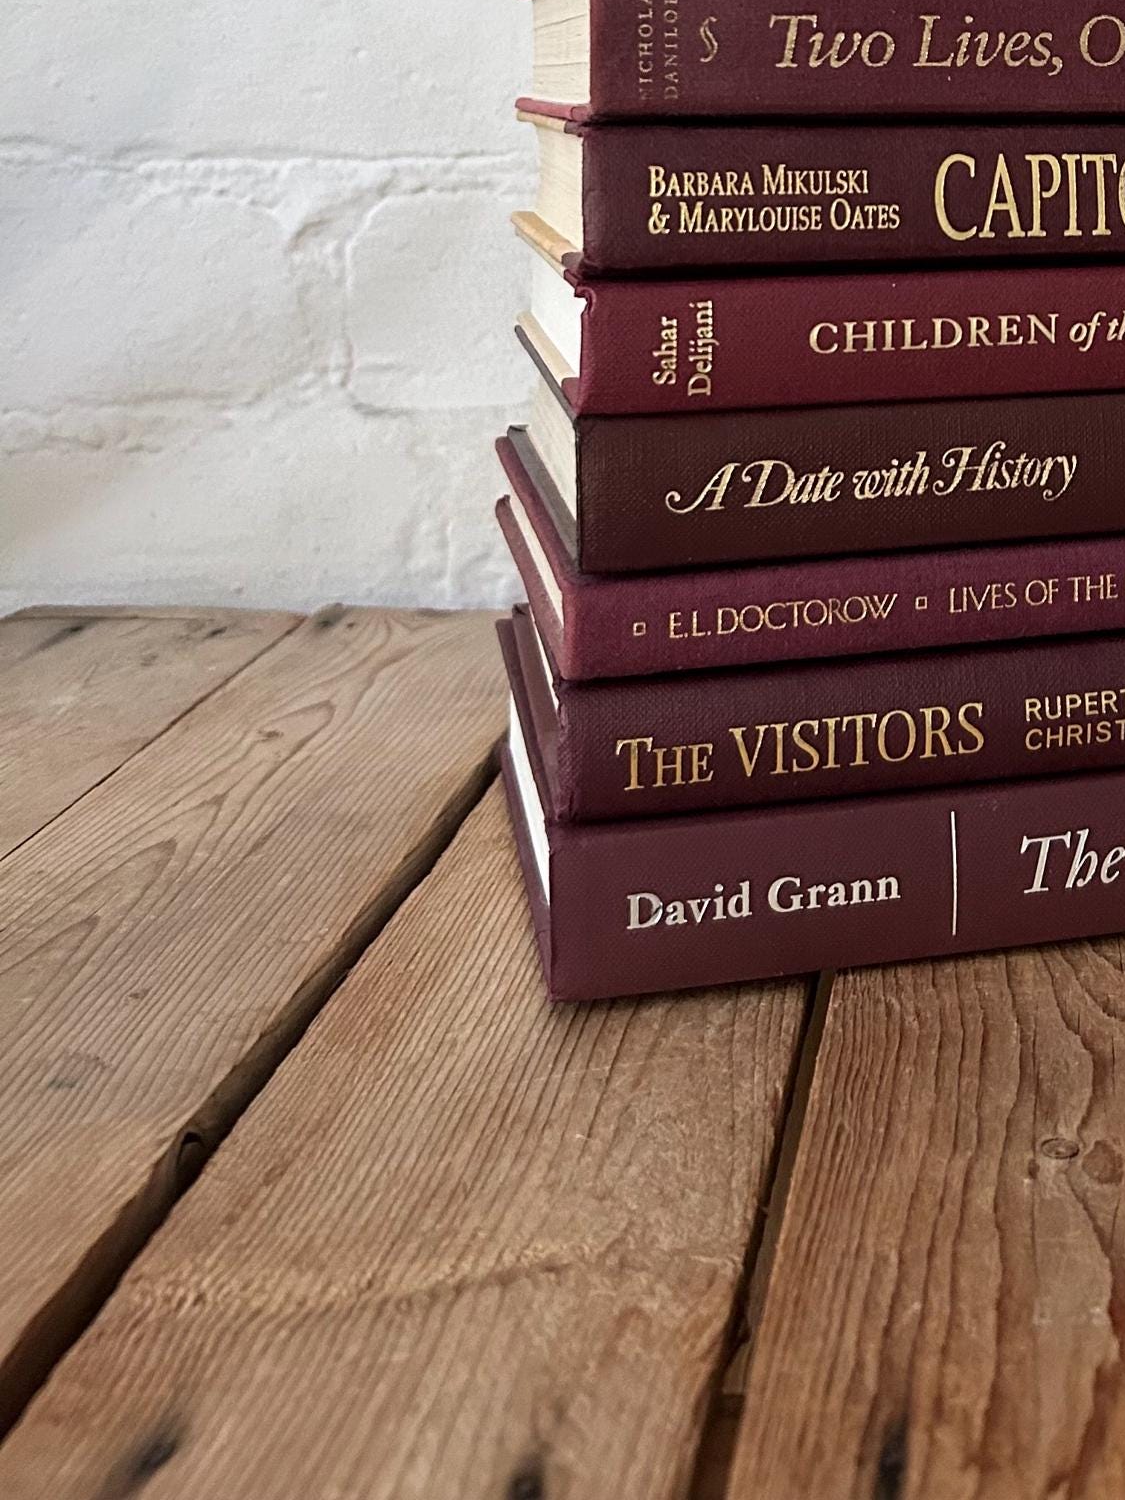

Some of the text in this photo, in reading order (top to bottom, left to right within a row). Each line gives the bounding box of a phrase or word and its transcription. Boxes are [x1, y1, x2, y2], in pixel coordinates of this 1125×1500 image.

[769, 14, 895, 68] Two
[912, 14, 1063, 76] Lives,
[647, 164, 869, 198] BARBARA MIKULSKI
[647, 199, 900, 235] & MARYLOUISE OATES
[653, 317, 678, 385] Sahar
[686, 299, 719, 396] Delijani
[808, 313, 1058, 354] CHILDREN
[1068, 311, 1107, 352] of
[665, 440, 1079, 514] A Date with History
[716, 593, 898, 635] DOCTOROW
[948, 582, 1017, 615] LIVES
[1024, 578, 1060, 606] OF
[1066, 573, 1120, 602] THE
[615, 702, 987, 792] THE VISITORS
[625, 873, 901, 930] David Grann
